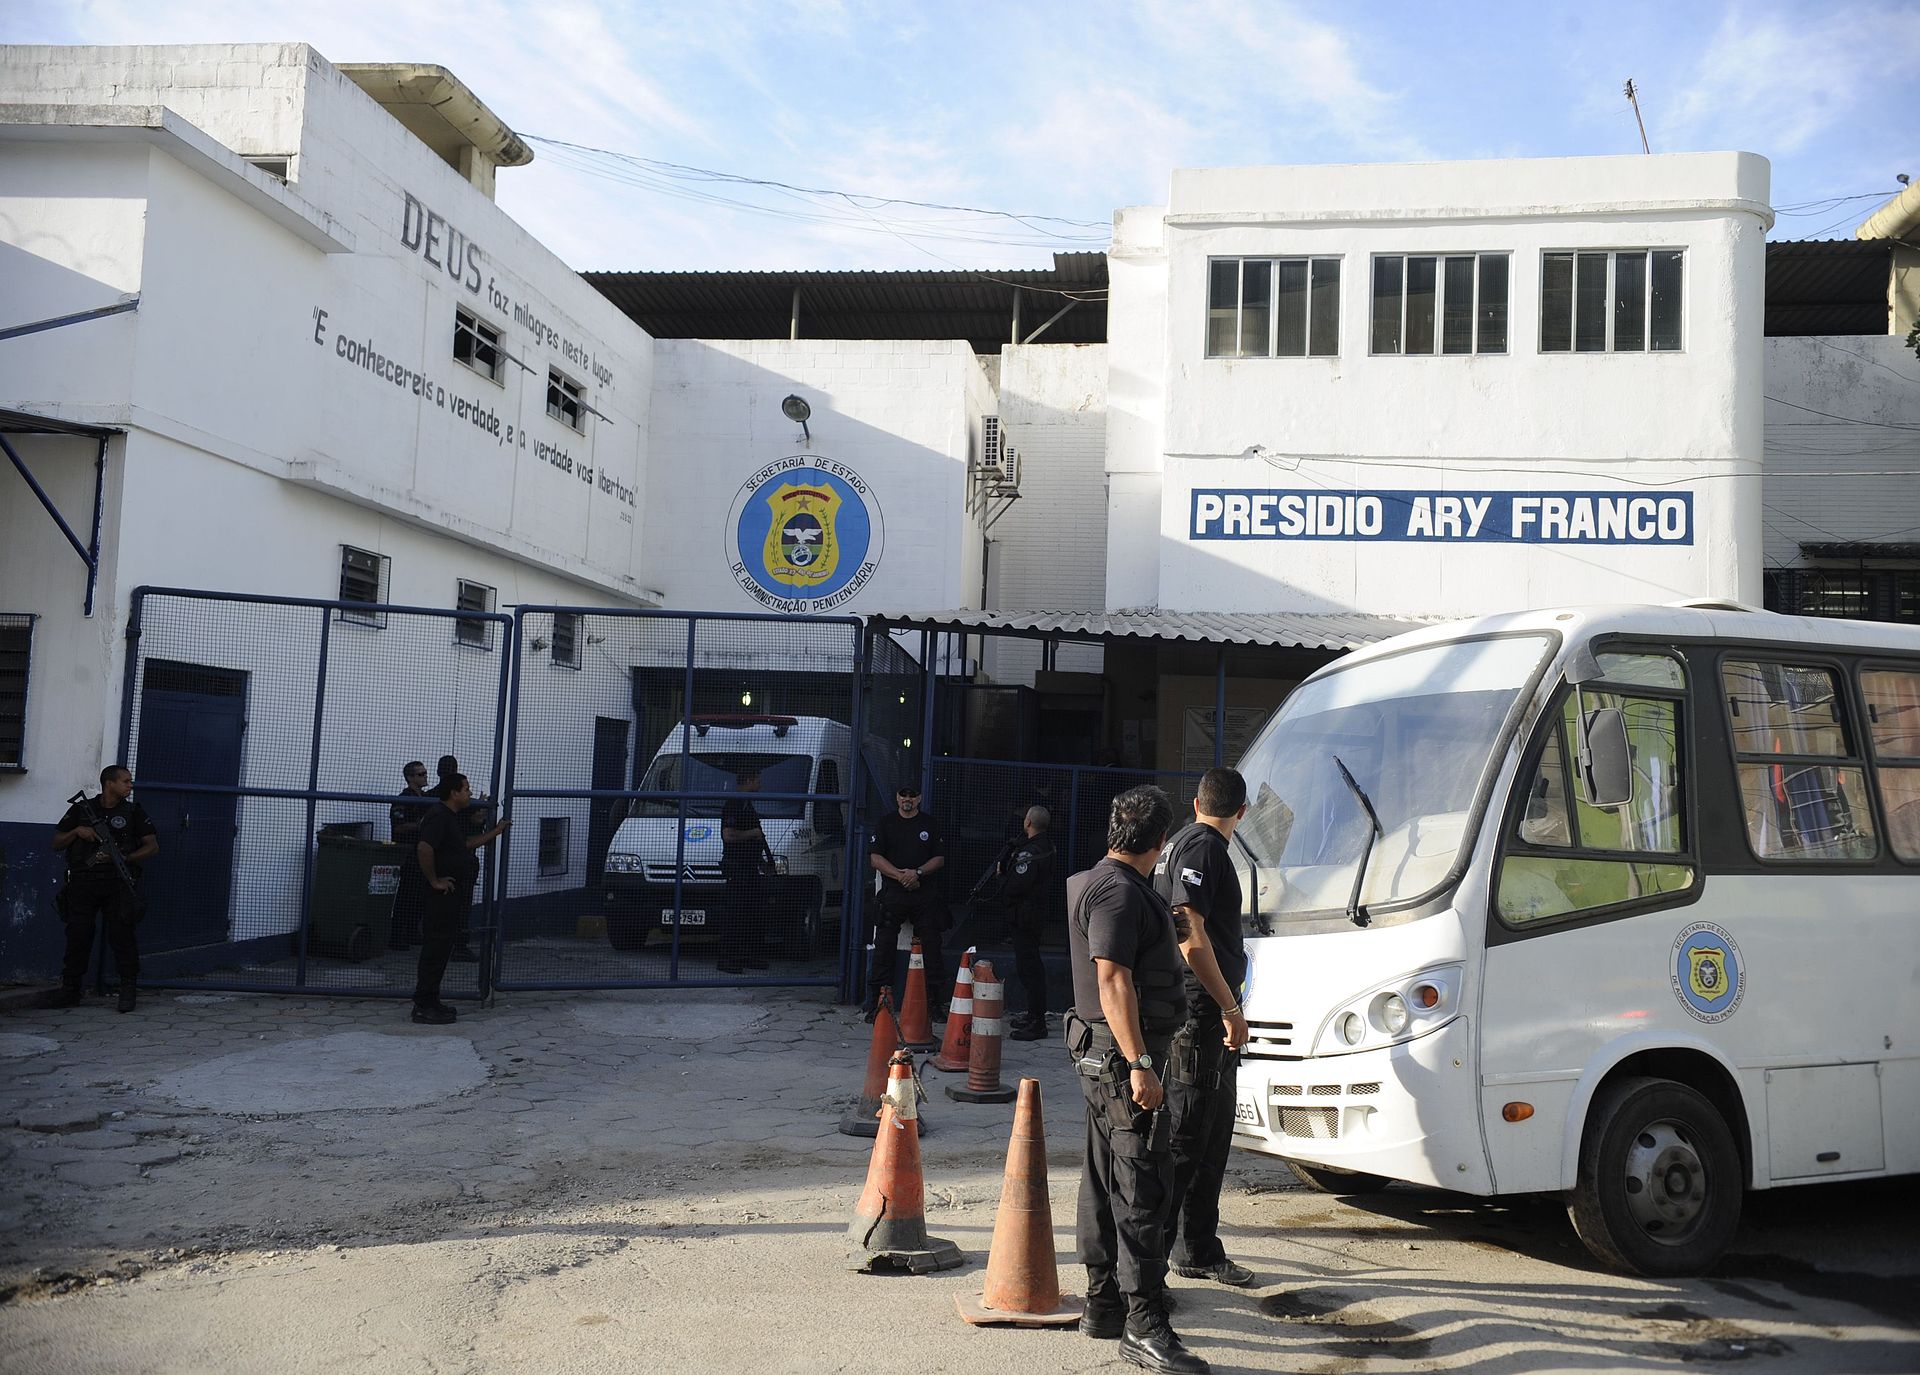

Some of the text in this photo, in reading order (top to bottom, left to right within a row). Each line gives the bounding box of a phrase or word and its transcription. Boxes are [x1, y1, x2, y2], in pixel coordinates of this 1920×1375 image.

[401, 189, 482, 296] DEUS
[488, 277, 509, 315] faz
[514, 302, 559, 349] milagres
[562, 338, 589, 370] neste
[335, 334, 434, 401] conhecereis
[436, 386, 445, 408] a
[449, 393, 504, 447] verdade,
[506, 425, 514, 444] e
[519, 430, 526, 450] a
[533, 439, 573, 474] verdade
[577, 462, 594, 485] vos
[746, 457, 867, 495] SECRETARIA DE ESTADO
[1195, 495, 1687, 540] PRESIDIO ARY FRANCO
[732, 561, 746, 577] DE
[741, 576, 807, 613] ADMINISTRAÇÃO
[1674, 923, 1706, 950] SECRETARIA
[1716, 927, 1737, 951] ESTADO
